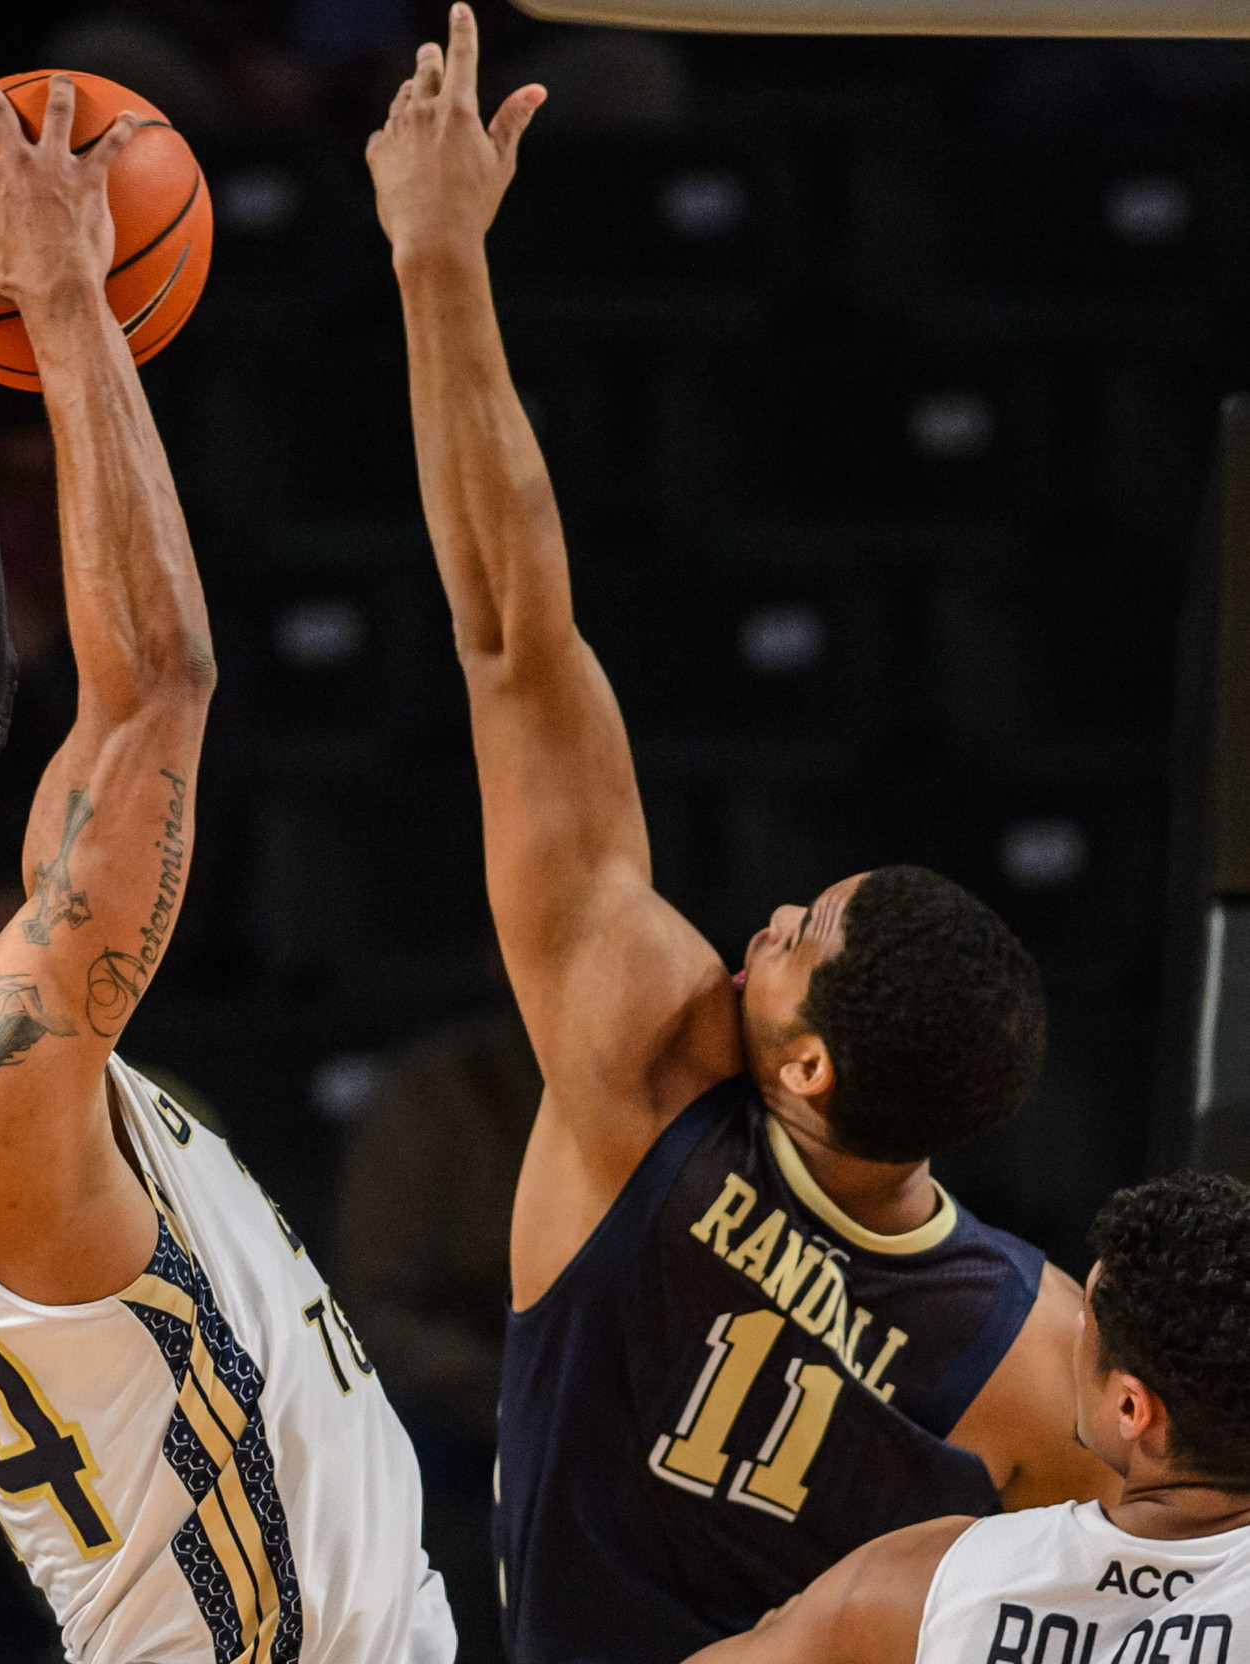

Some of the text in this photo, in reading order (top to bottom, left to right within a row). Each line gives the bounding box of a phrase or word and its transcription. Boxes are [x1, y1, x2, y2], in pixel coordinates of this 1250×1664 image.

[86, 768, 188, 1038] Determined
[649, 1308, 844, 1523] 11
[1096, 1560, 1194, 1602] ACC
